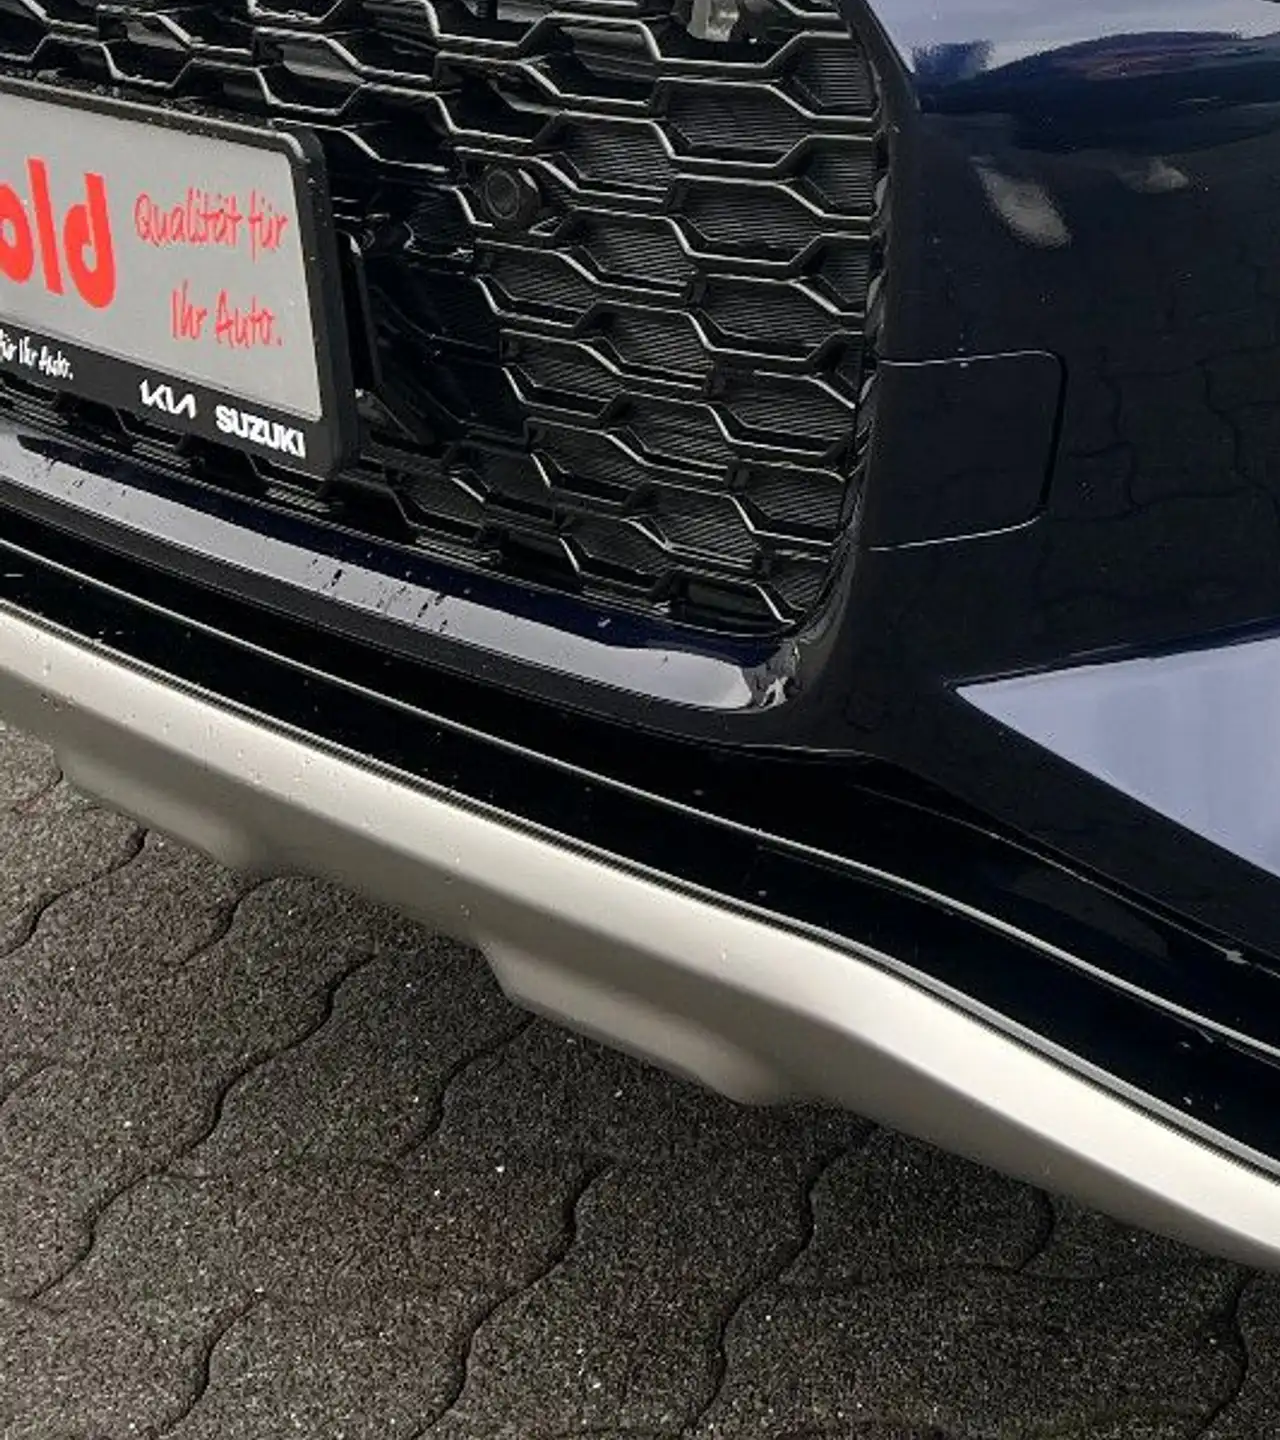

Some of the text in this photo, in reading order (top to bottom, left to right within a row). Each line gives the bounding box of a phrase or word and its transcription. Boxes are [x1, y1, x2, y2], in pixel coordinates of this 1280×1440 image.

[134, 187, 288, 262] Qualität für
[170, 279, 282, 348] Ihr Auto.
[215, 405, 306, 458] SUZUKI
